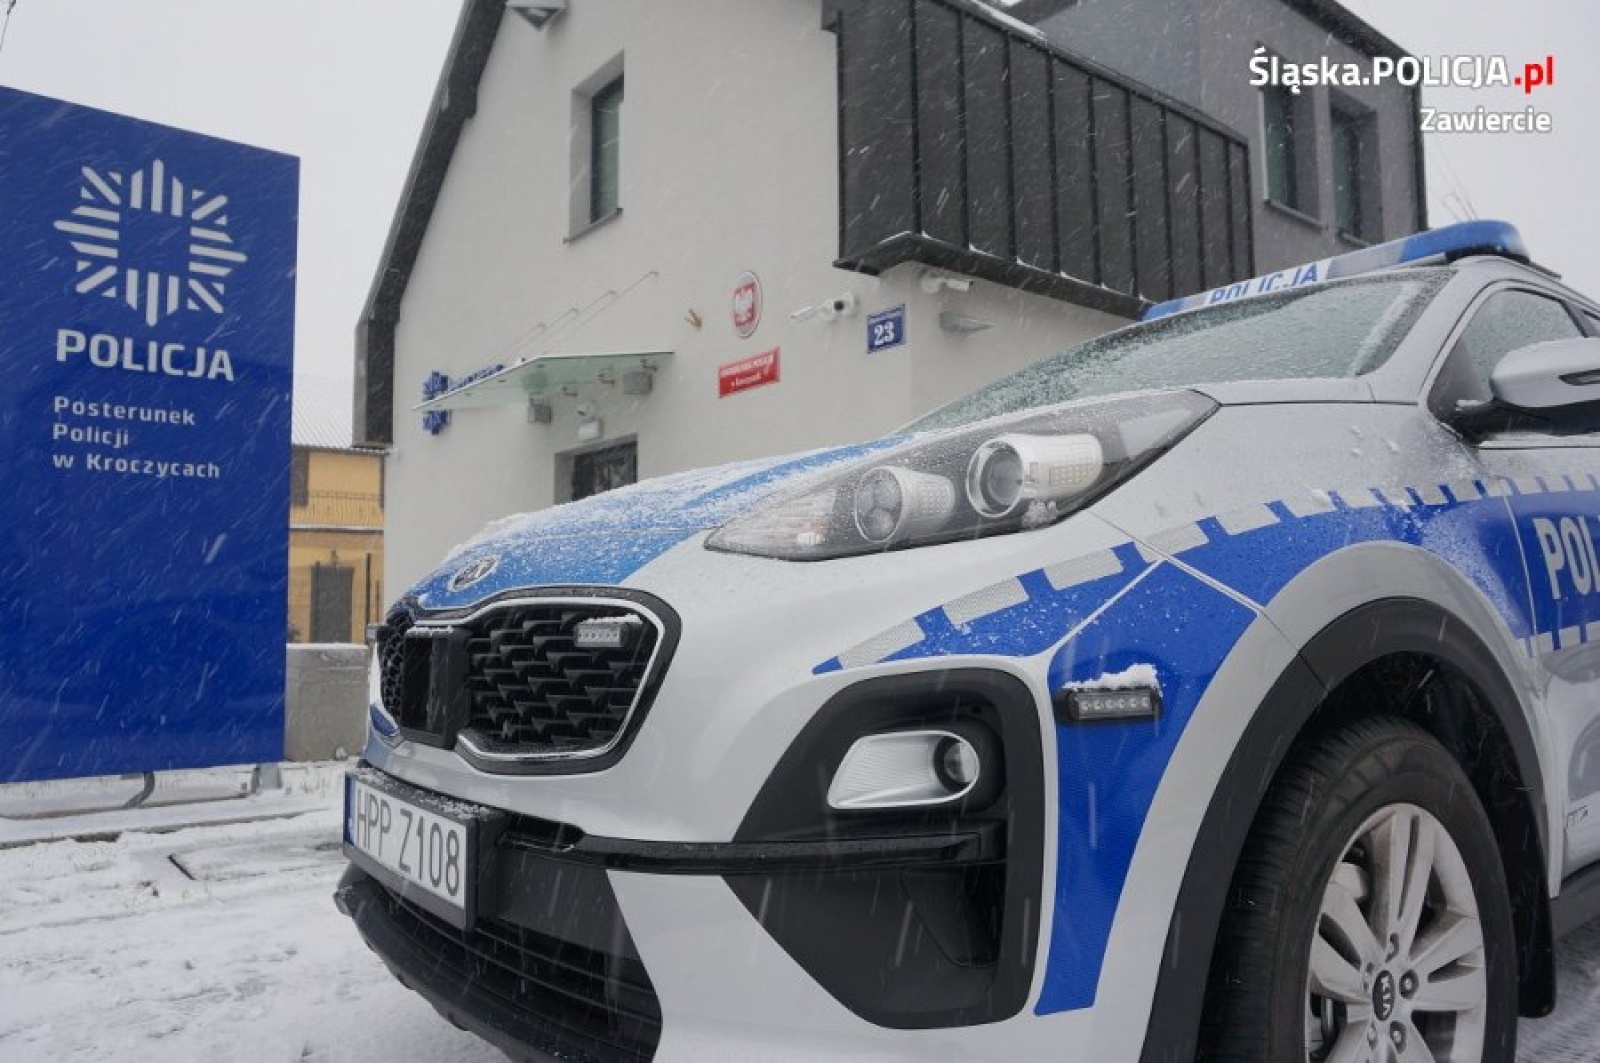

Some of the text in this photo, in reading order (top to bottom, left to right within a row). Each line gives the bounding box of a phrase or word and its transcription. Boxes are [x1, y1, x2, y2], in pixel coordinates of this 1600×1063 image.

[1208, 262, 1318, 304] POLICJA
[874, 321, 895, 346] 23
[56, 328, 236, 382] POLICJA
[54, 395, 196, 426] Posterunek
[52, 422, 130, 449] Policji
[52, 452, 221, 479] w Kroczycach
[1532, 514, 1600, 600] POL
[356, 788, 460, 897] HPP Z108
